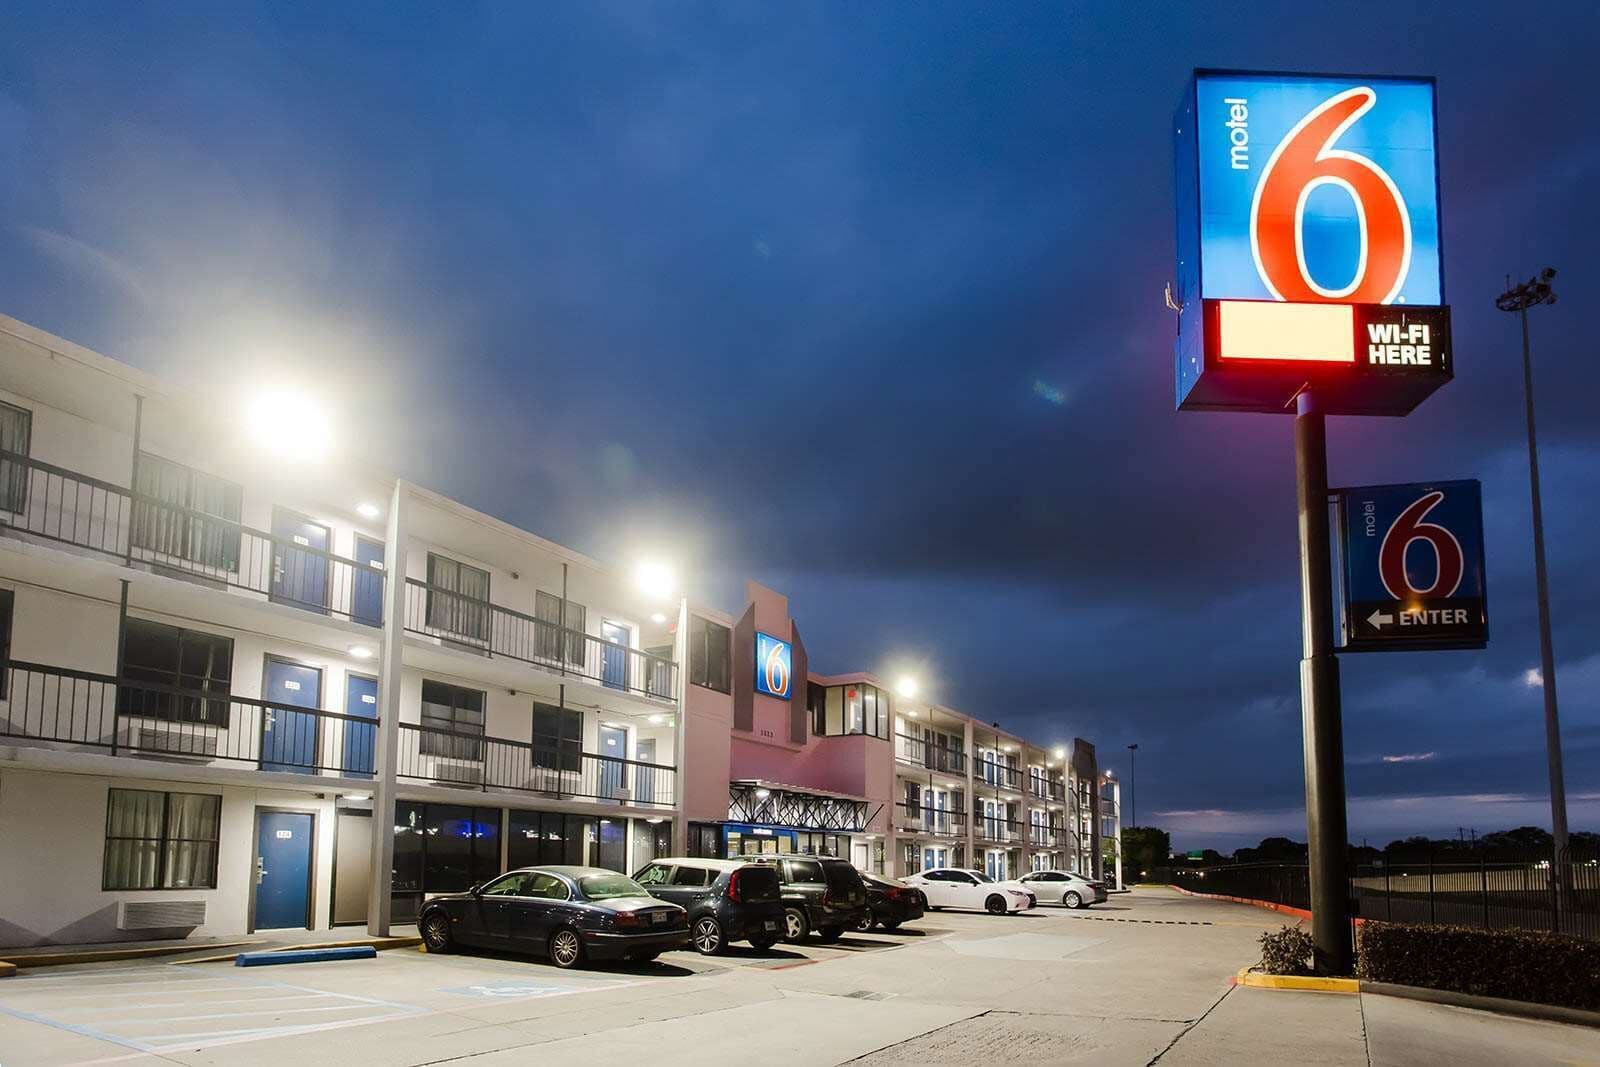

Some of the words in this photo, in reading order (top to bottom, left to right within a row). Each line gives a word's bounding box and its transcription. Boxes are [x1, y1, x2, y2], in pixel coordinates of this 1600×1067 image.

[1224, 98, 1249, 169] motel
[1249, 86, 1412, 305] 6
[1367, 323, 1430, 345] WI-FI
[1368, 344, 1432, 365] HERE
[1379, 491, 1463, 600] 6
[1399, 608, 1468, 626] ENTER
[766, 643, 788, 696] 6
